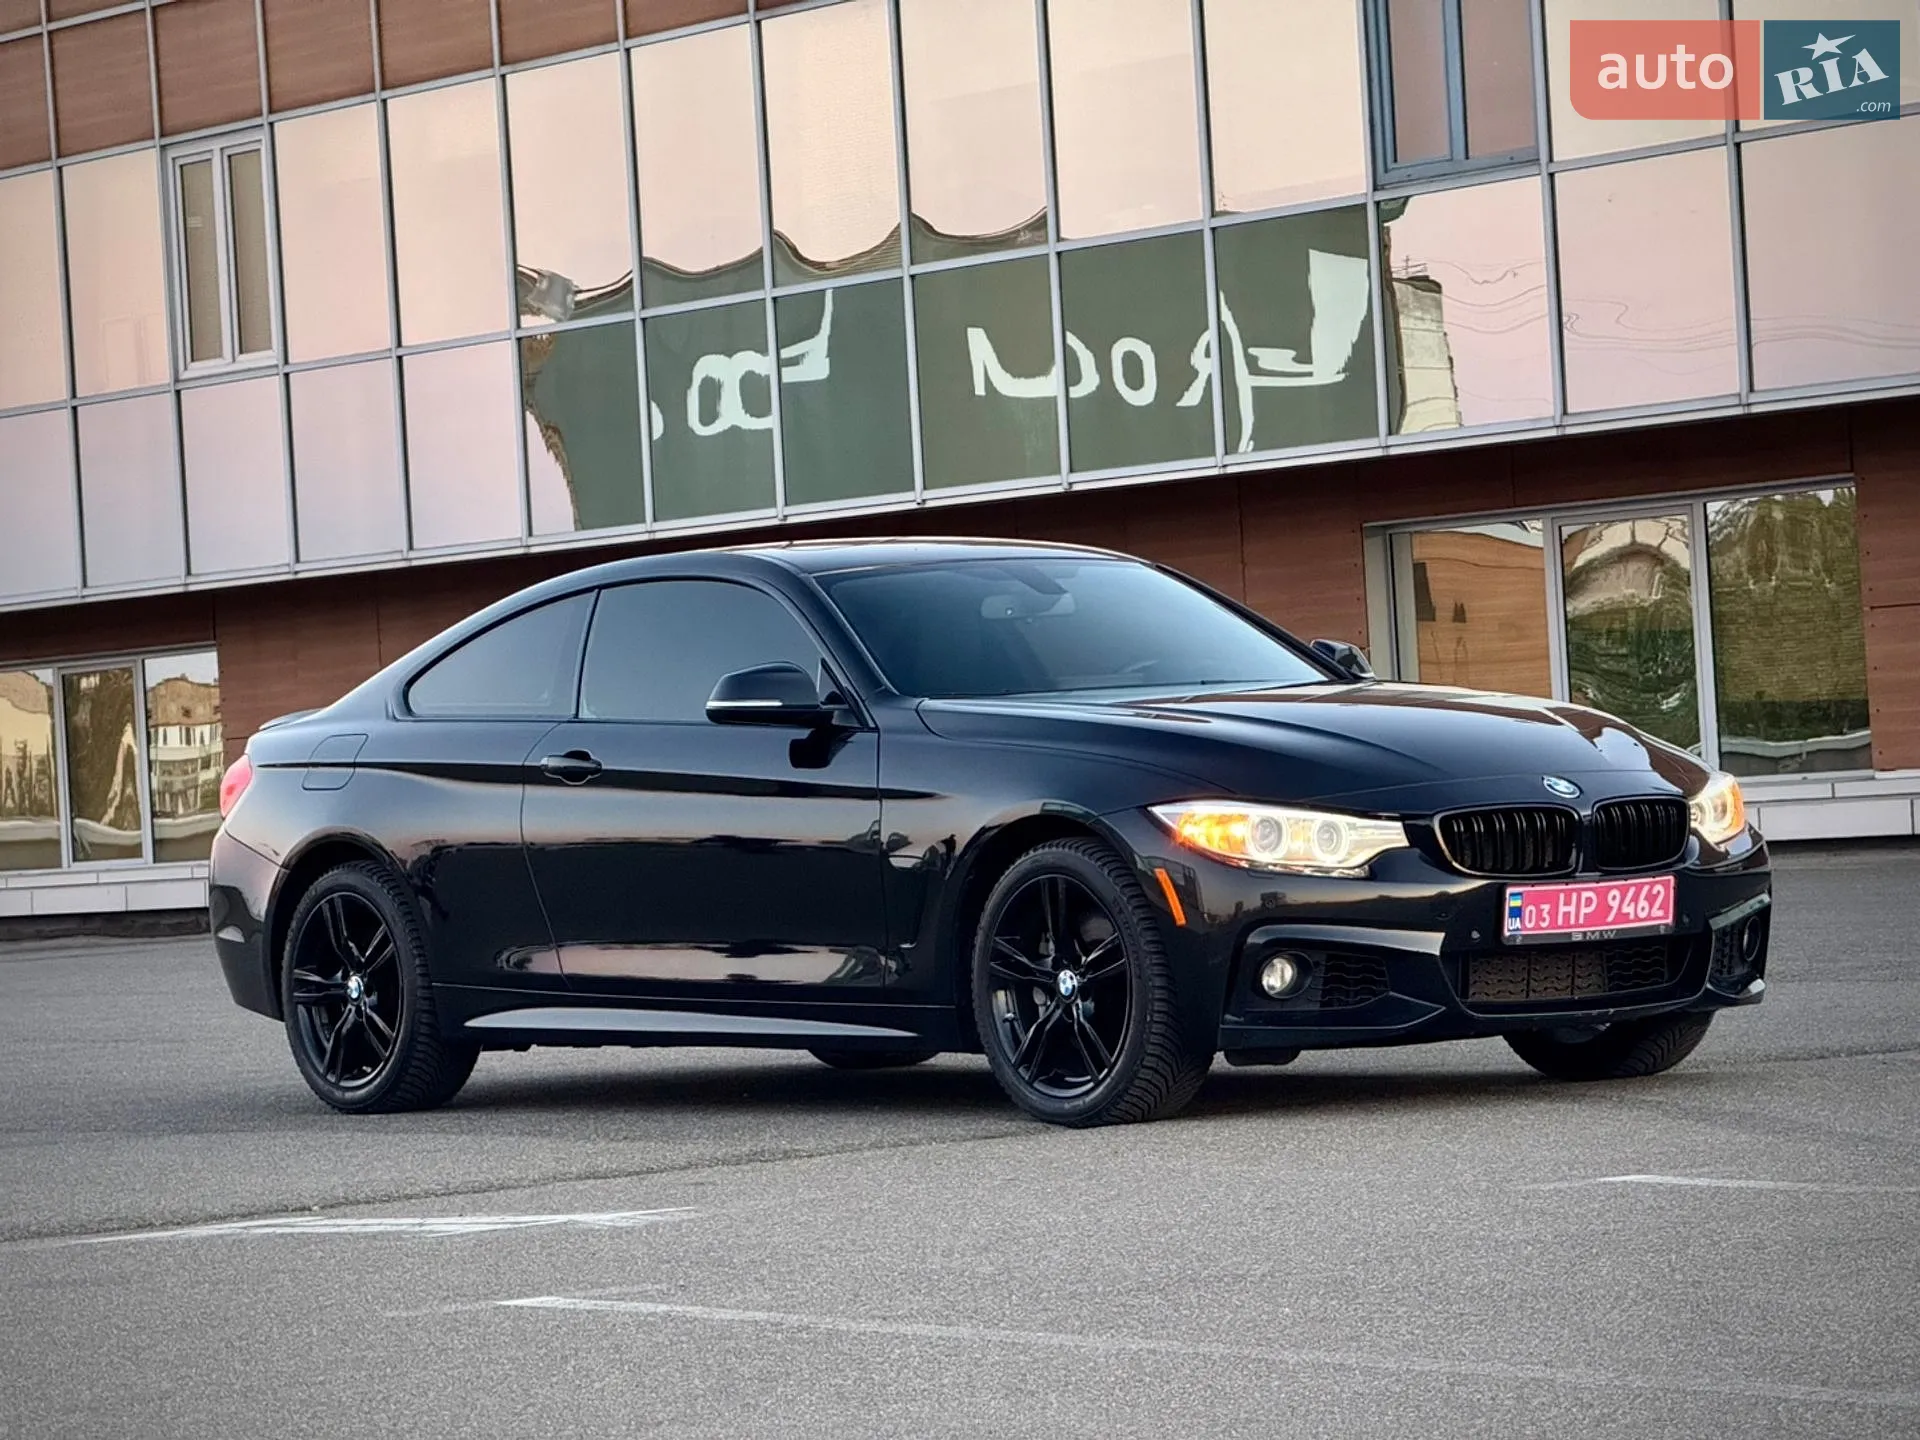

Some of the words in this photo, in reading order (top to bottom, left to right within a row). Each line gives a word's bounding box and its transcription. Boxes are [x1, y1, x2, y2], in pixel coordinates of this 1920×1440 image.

[1524, 903, 1551, 929] 03
[1557, 891, 1598, 926] HP
[1605, 883, 1665, 923] 9462
[1507, 917, 1522, 930] UA
[1571, 930, 1617, 941] BMW
